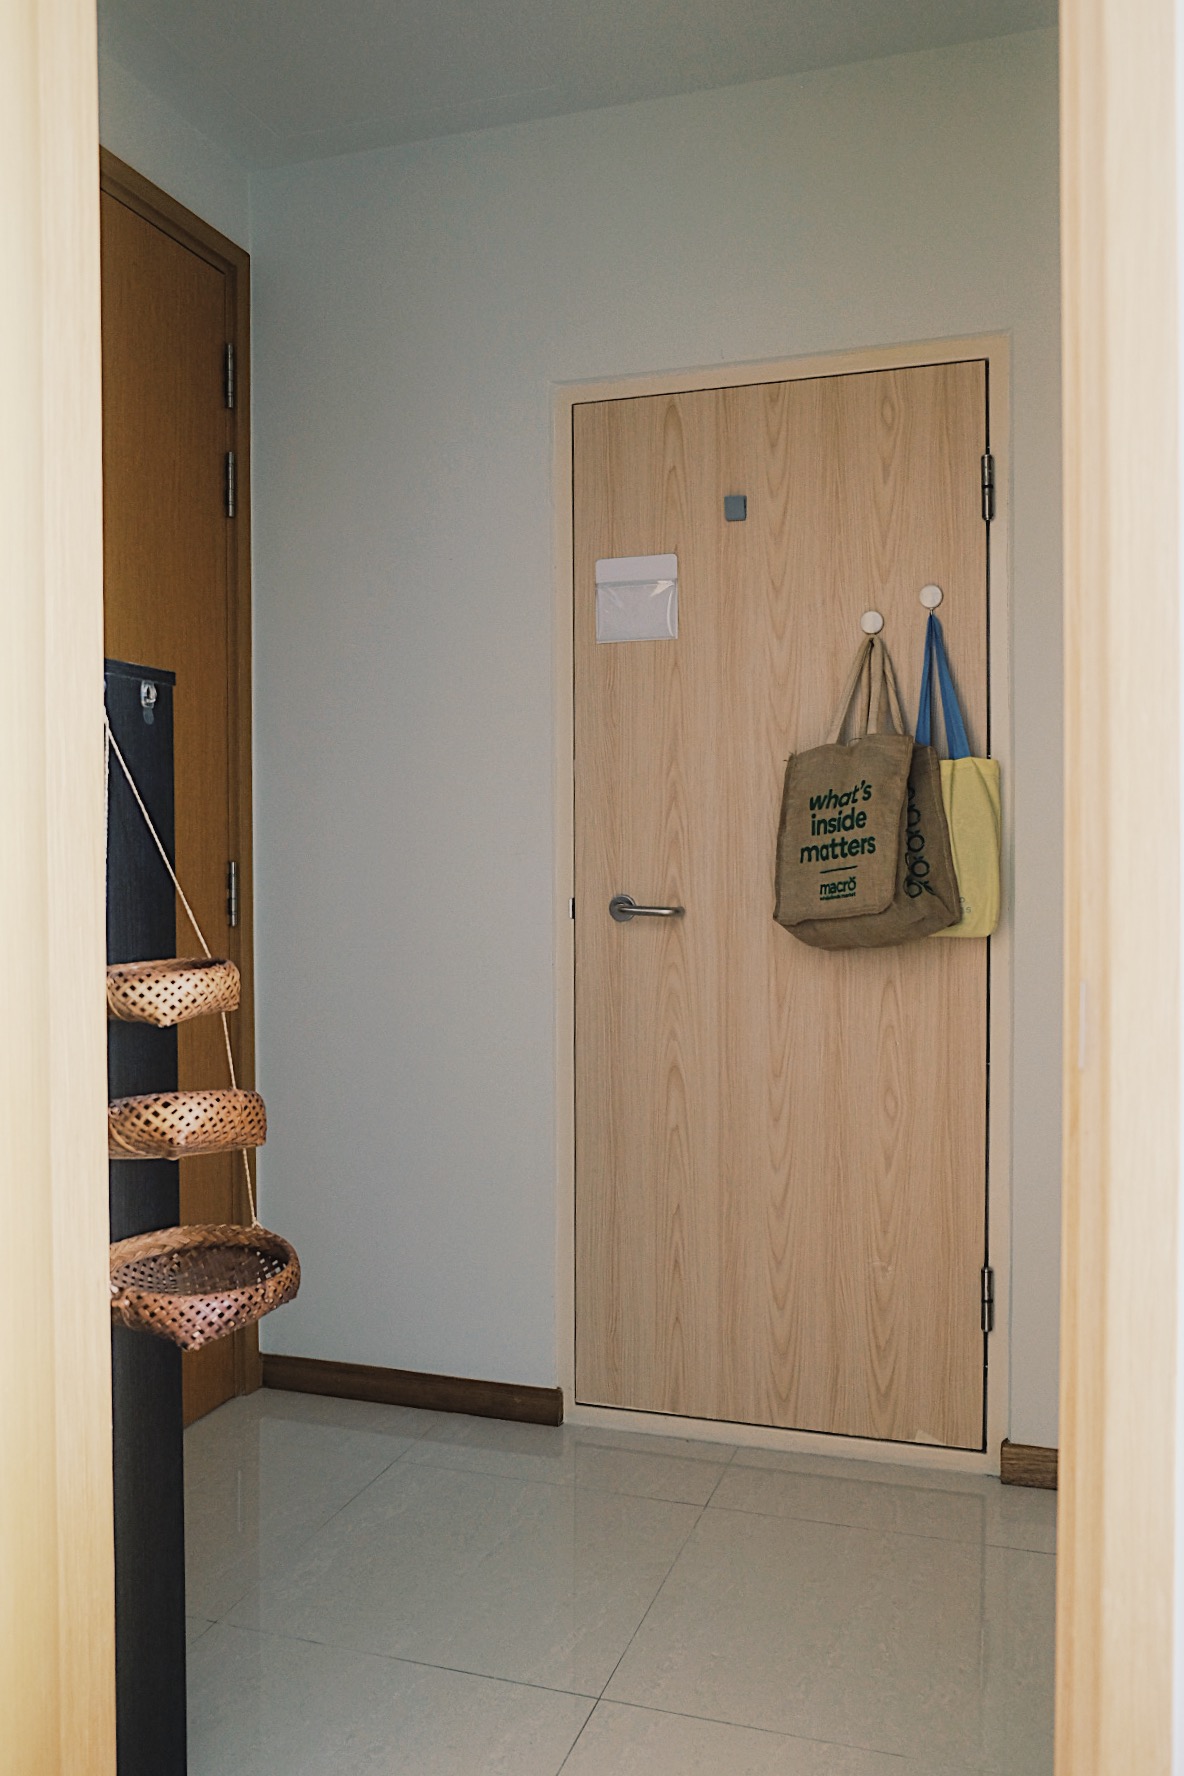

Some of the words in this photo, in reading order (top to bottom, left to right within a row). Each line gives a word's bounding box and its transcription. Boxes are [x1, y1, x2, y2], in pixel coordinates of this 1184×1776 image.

[809, 780, 872, 810] what's
[811, 807, 867, 836] inside
[800, 836, 876, 863] matters
